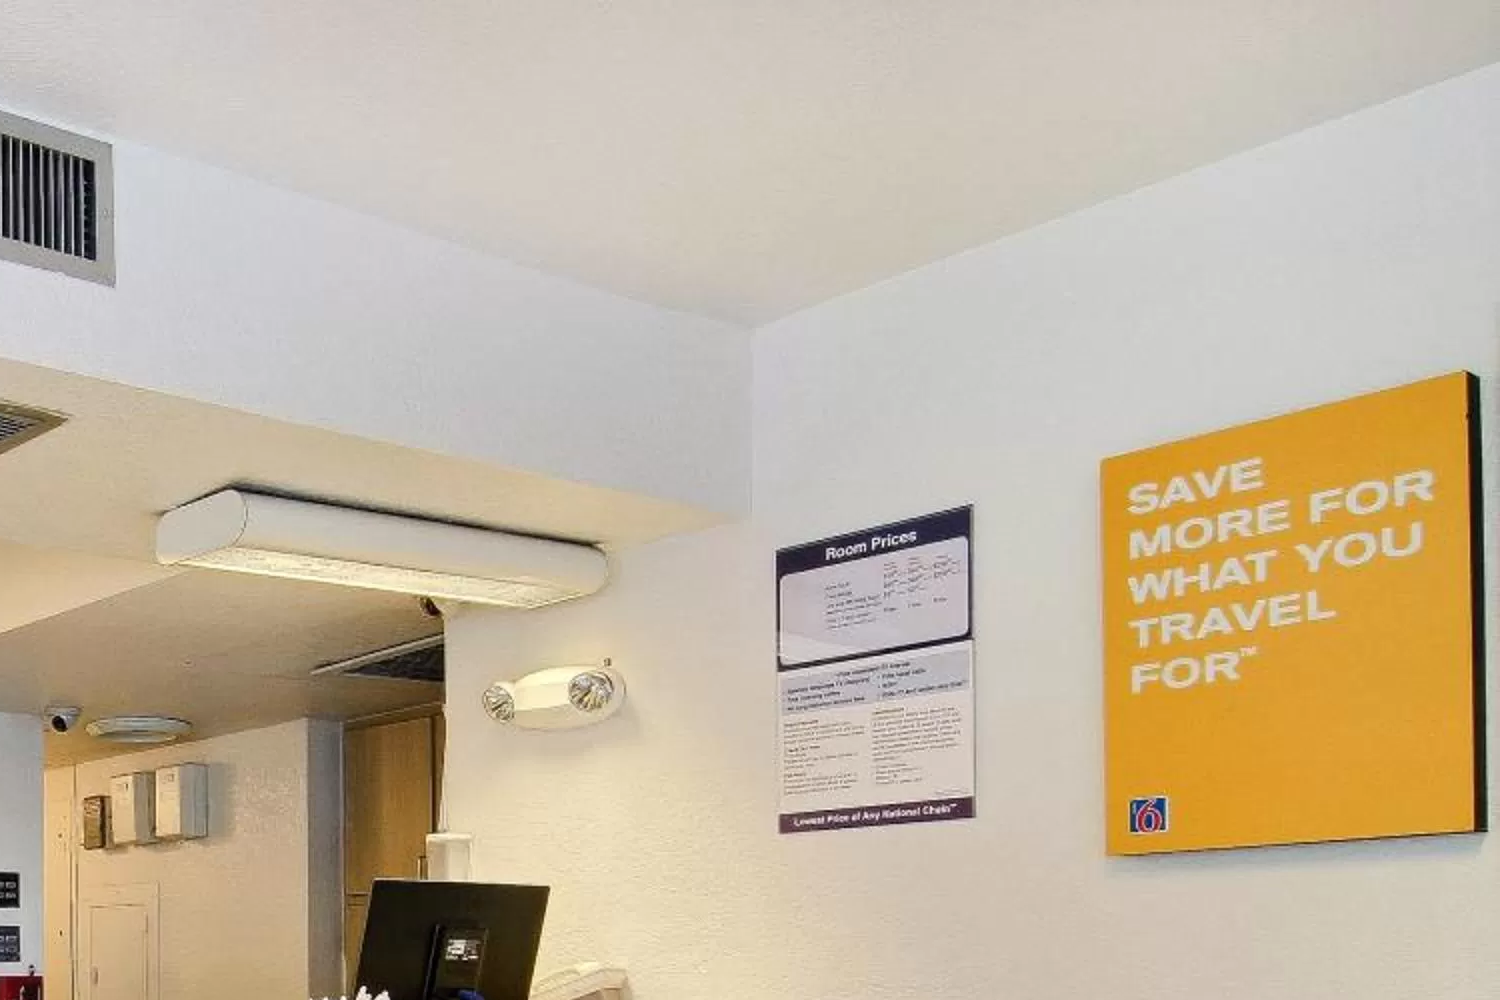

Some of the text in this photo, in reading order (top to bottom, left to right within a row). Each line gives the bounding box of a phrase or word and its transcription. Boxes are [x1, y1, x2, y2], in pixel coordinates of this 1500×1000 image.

[1127, 456, 1264, 515] SAVE
[1128, 469, 1435, 560] MORE FOR
[825, 530, 917, 561] Room Prices
[1127, 521, 1423, 605] WHAT YOU
[1128, 590, 1337, 649] TRAVEL
